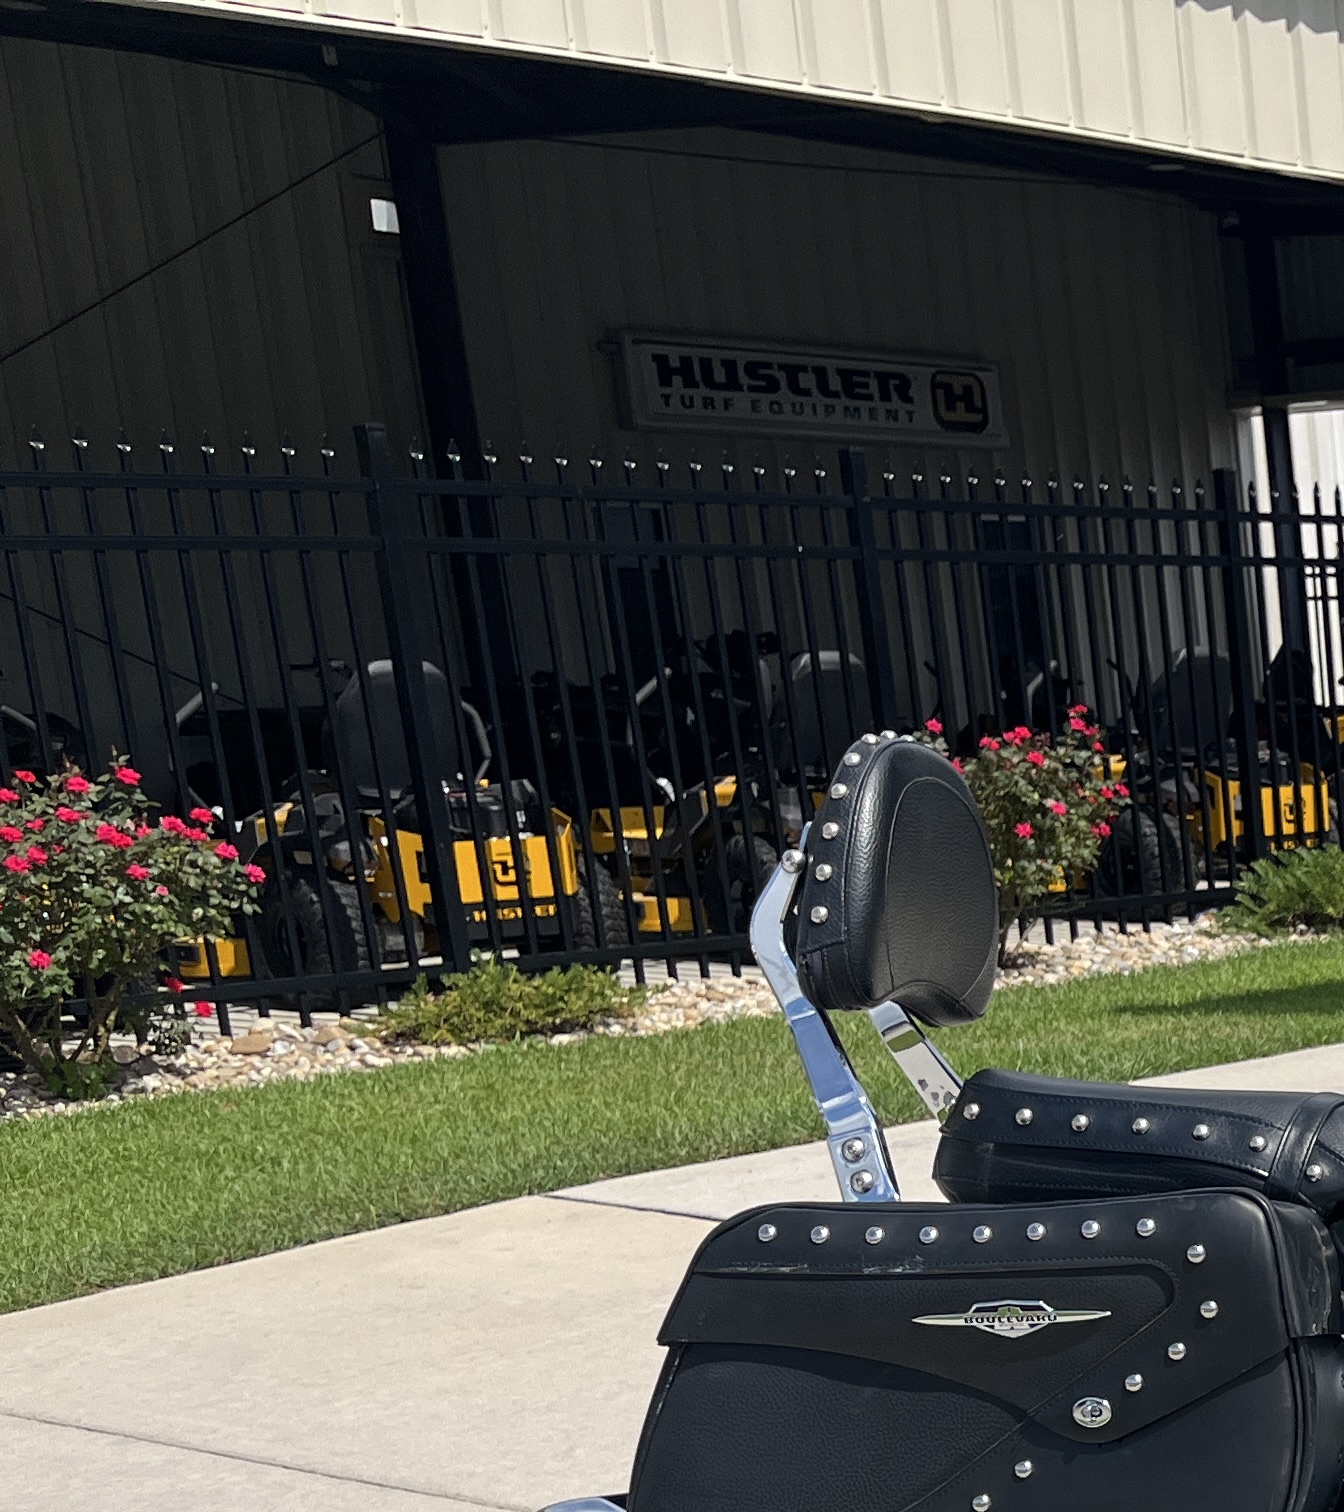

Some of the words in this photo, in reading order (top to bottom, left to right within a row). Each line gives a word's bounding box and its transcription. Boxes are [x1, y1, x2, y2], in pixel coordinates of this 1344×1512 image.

[651, 353, 915, 405] HUSTLER
[660, 392, 737, 412] TURF
[750, 397, 917, 425] EQUIPMENT
[963, 1314, 1058, 1325] BOULEVARD
